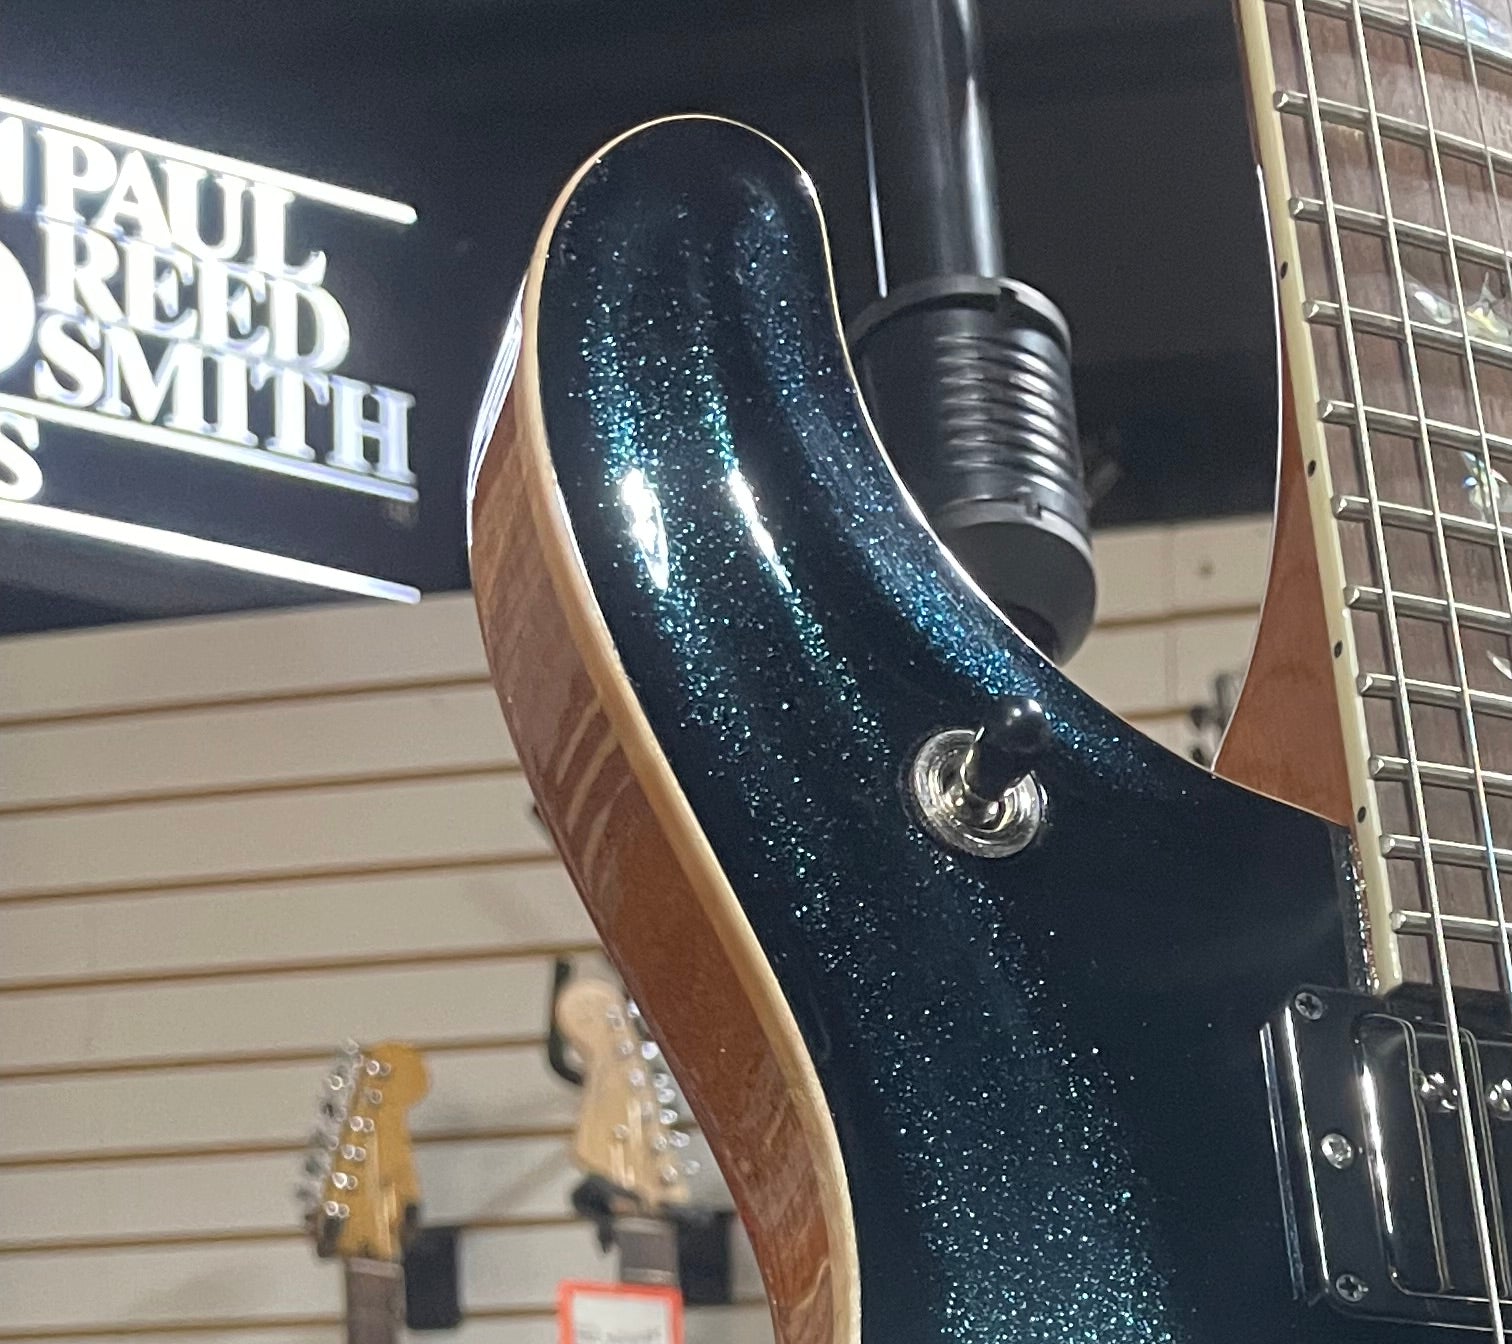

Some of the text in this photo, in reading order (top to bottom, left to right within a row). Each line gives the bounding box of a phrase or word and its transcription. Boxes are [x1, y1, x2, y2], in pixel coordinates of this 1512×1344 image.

[37, 126, 327, 287] PAUL
[37, 212, 351, 372] REED
[35, 311, 417, 484] SMITH
